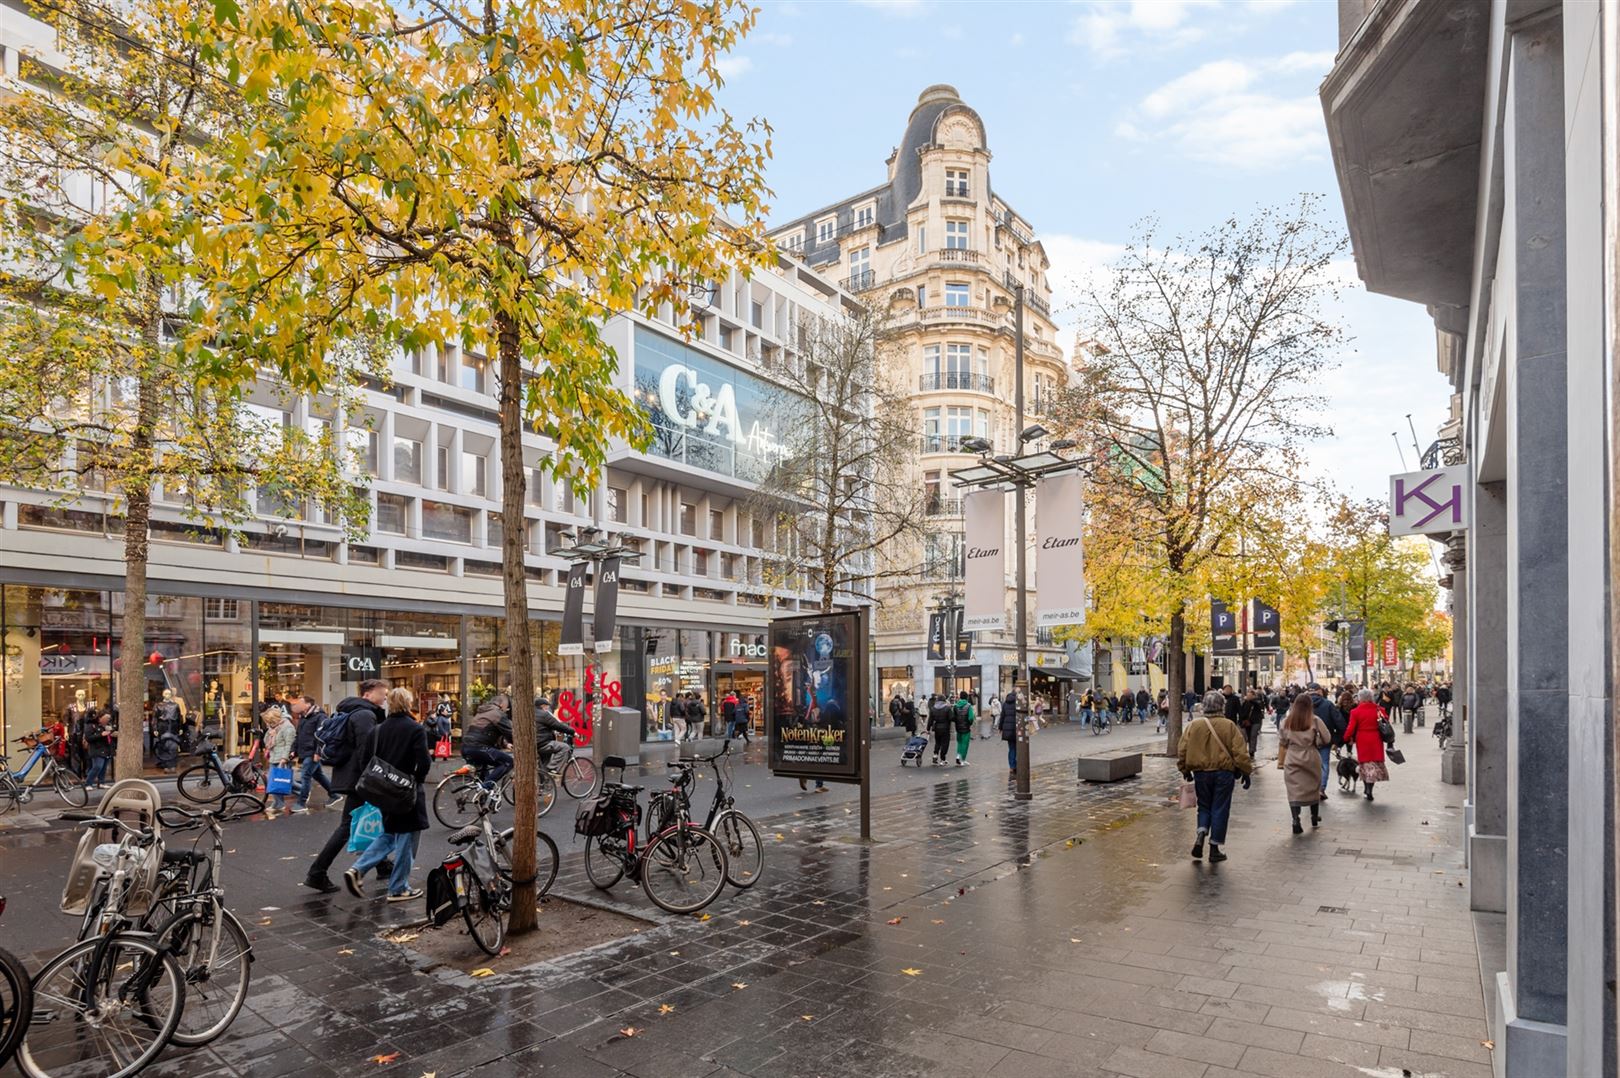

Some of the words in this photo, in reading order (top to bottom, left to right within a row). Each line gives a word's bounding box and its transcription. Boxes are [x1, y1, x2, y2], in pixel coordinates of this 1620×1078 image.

[659, 364, 746, 443] C&A
[1042, 536, 1079, 550] Etam
[967, 547, 999, 560] Etam
[730, 639, 767, 657] fnac
[349, 657, 375, 671] C&A
[650, 656, 675, 666] BLACK
